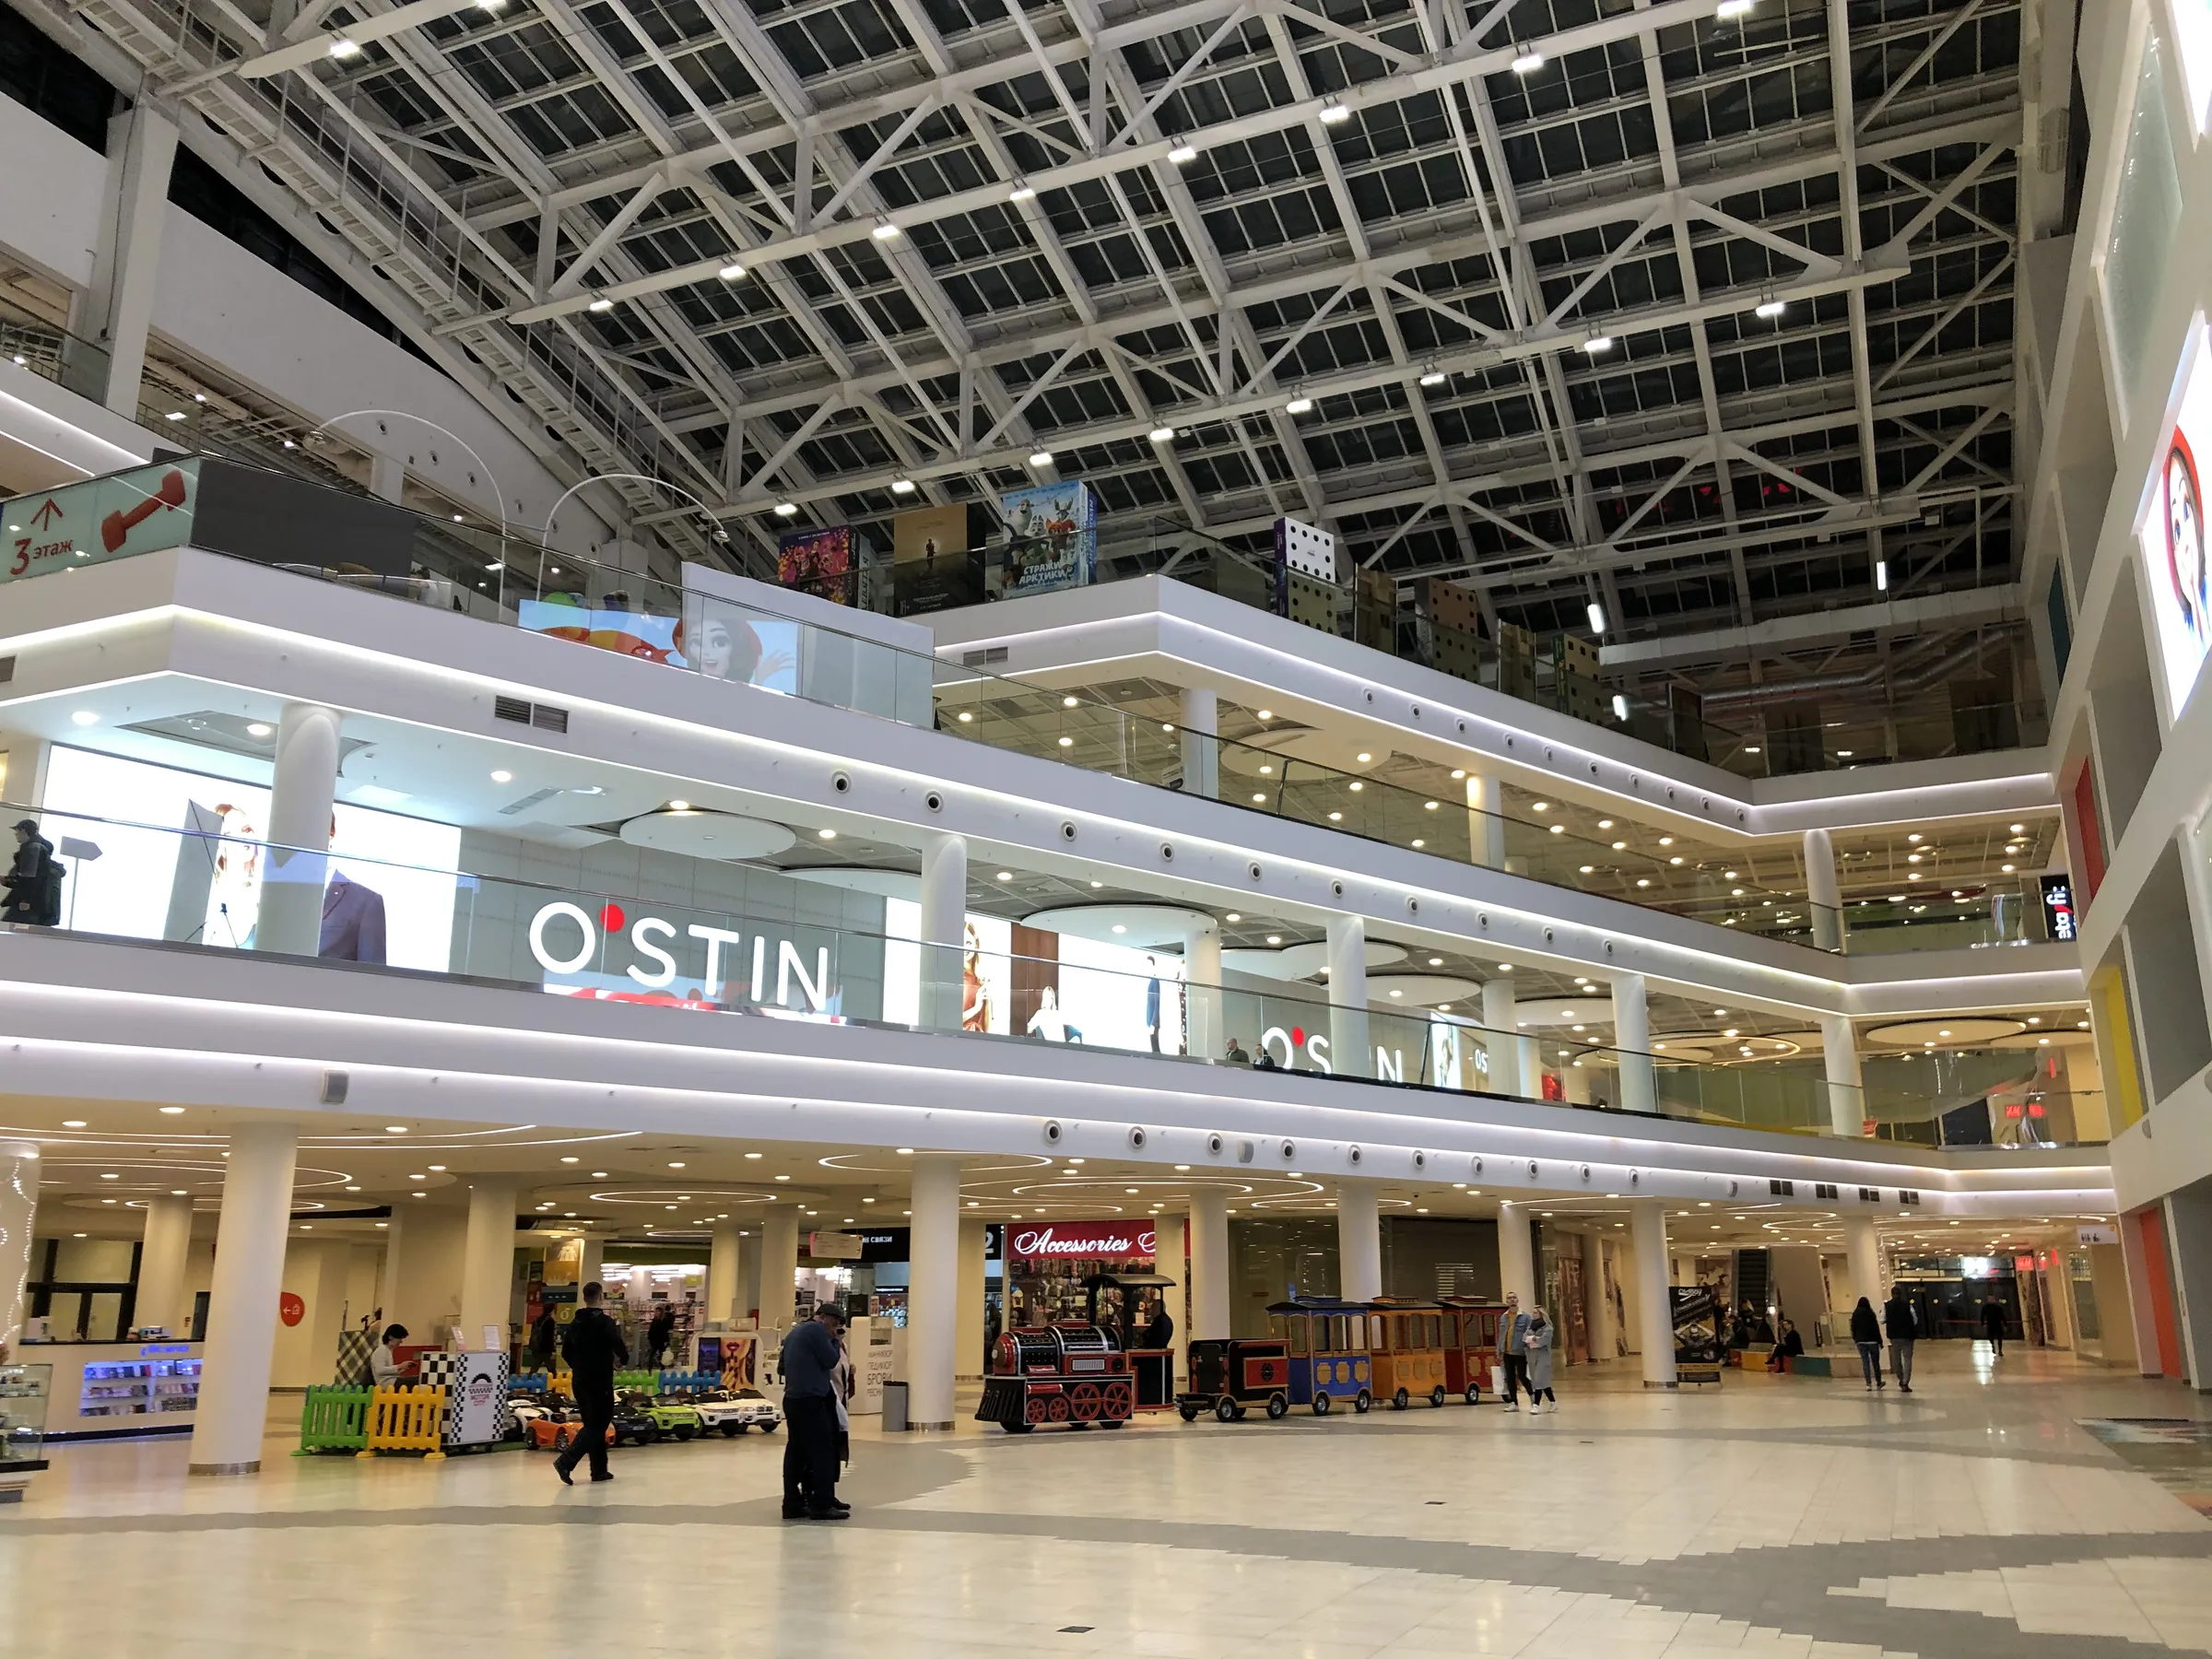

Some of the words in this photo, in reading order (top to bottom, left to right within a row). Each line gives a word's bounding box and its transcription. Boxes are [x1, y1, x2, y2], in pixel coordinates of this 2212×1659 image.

[10, 537, 32, 576] 3
[32, 539, 74, 559] этаж
[1023, 559, 1062, 575] СТРАЖИ
[1018, 570, 1066, 585] АРКТИКИ
[529, 901, 829, 1011] O'STIN
[1014, 1228, 1133, 1255] Accessories
